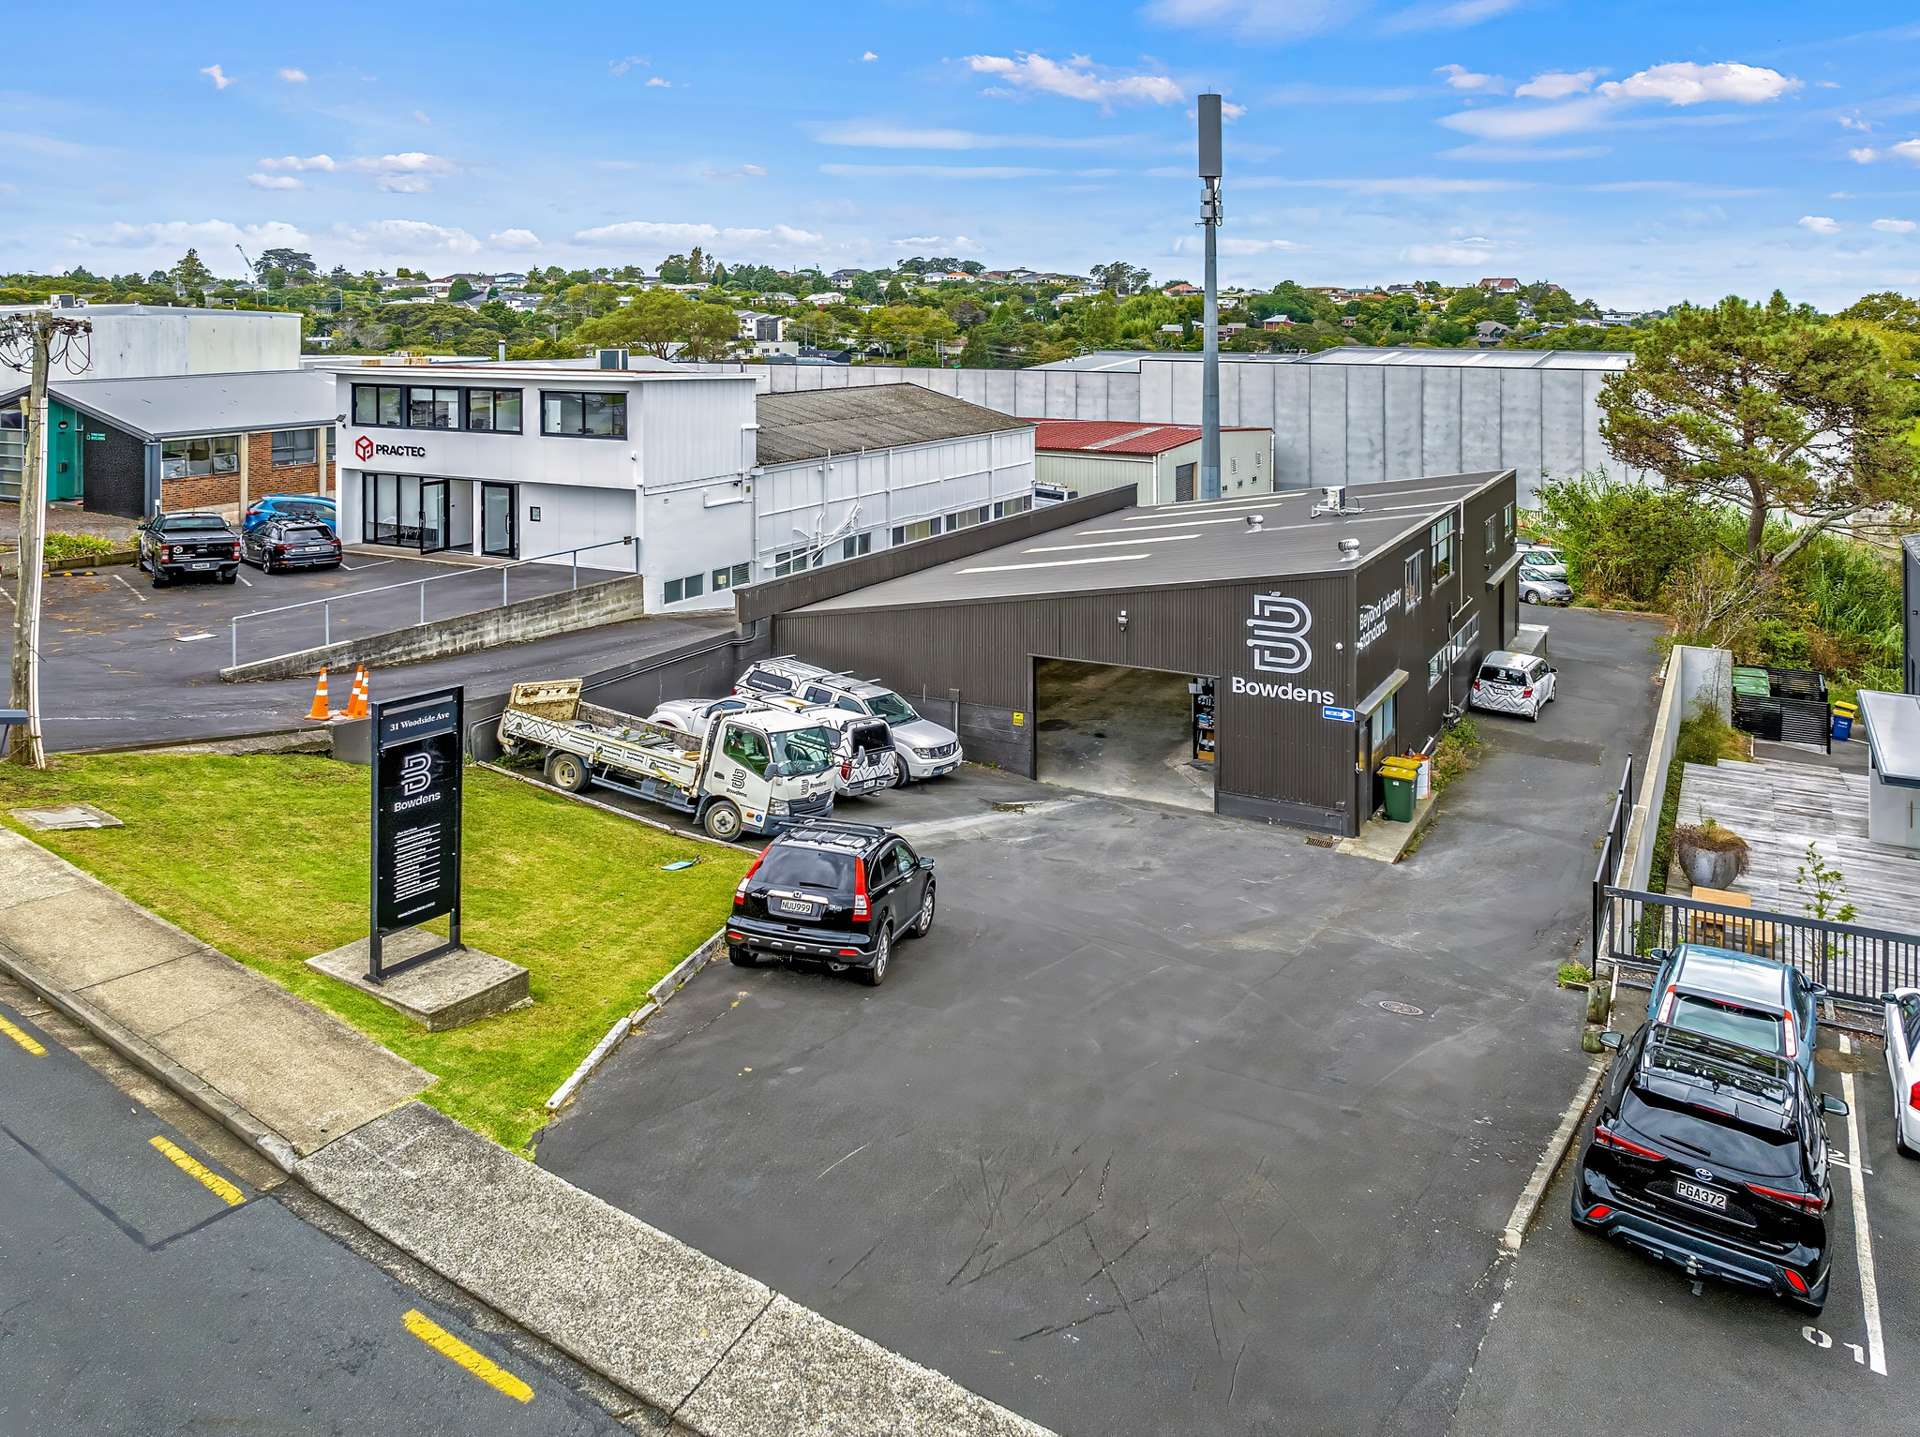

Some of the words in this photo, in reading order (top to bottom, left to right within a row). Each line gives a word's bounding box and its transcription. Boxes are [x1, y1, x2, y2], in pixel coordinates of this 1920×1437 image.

[376, 444, 426, 457] PRACTEC
[1359, 600, 1381, 631] Beyond
[1381, 588, 1401, 616] industry
[1231, 676, 1335, 705] Bowdens
[390, 723, 399, 731] 31
[400, 715, 435, 728] Woodside
[435, 712, 450, 721] Ave
[393, 791, 441, 813] Bowdens
[1678, 1182, 1726, 1208] PGA372
